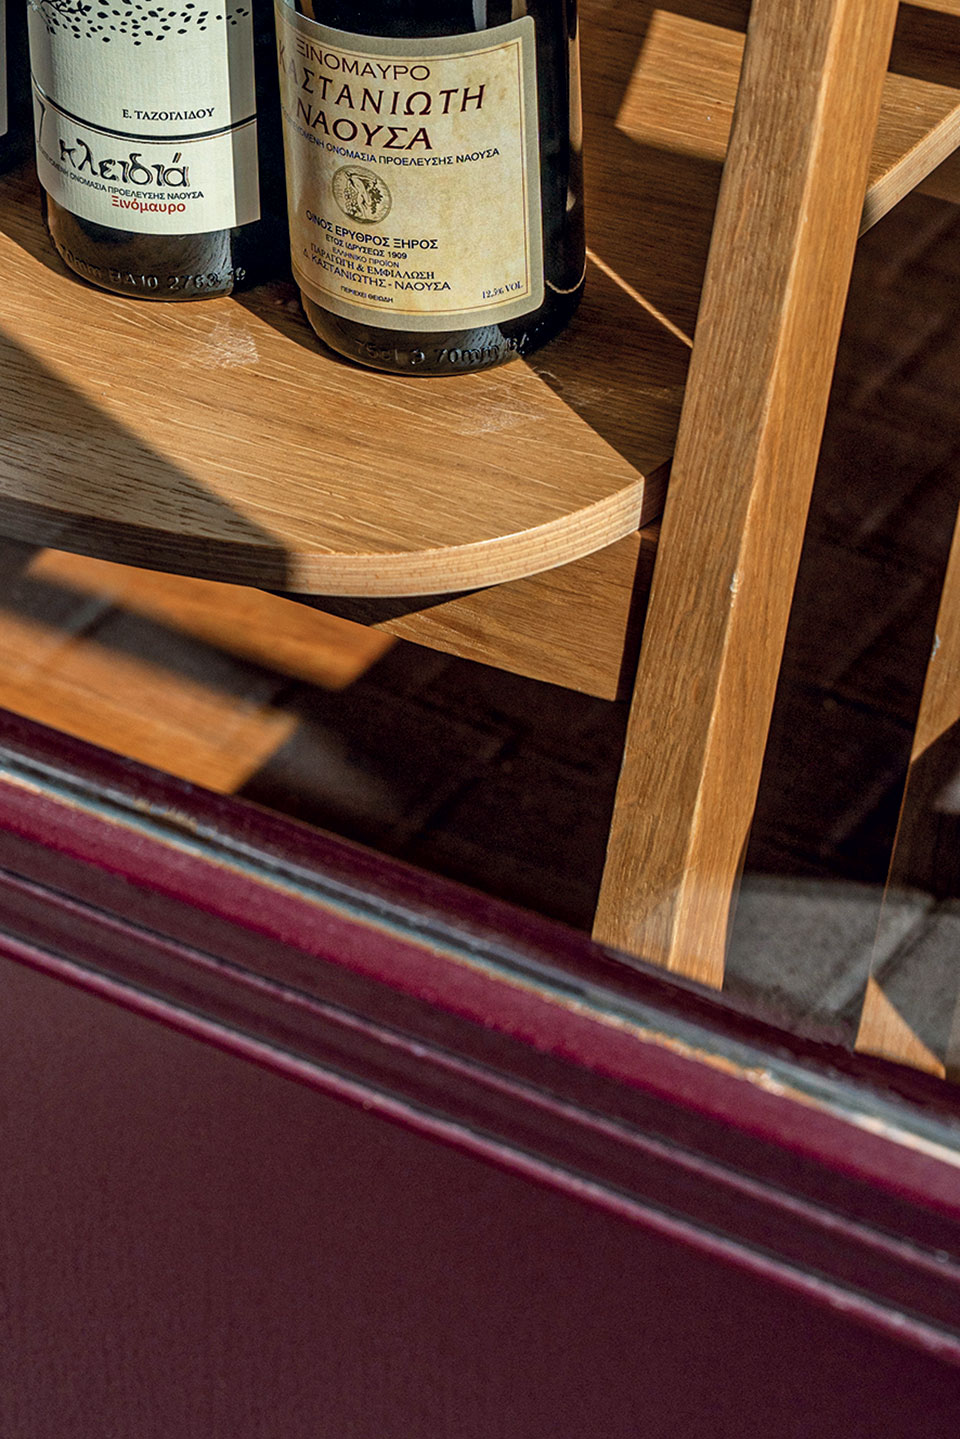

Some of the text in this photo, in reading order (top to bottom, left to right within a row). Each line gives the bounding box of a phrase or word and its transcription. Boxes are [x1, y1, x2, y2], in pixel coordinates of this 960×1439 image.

[296, 37, 430, 81] ΞΙΝΟΜΑΥΡΟ
[135, 107, 215, 121] ΤΑΖΟΓΛΙΔΟΥ
[297, 97, 433, 151] ΝΑΟΥΣΑ
[326, 142, 377, 163] ΟΝΟΜΑΣΙΑ
[378, 155, 454, 167] ΠΡΟΕΛΕΥΣΗΣ
[456, 147, 500, 163] ΝΑΟΥΣΑ
[108, 185, 165, 200] ΠΡΟΕΛΕΥΣΗΣ
[167, 191, 204, 200] ΝΑΟΥΣΑ
[111, 195, 186, 215] Ξινόμαυρο
[305, 210, 438, 250] ΟΙΝΟΣ ΕΡΥΘΡΟΣ ΞΗΡΟΣ
[325, 234, 344, 247] ΕΤΟΣ
[387, 251, 407, 260] 1909
[311, 255, 387, 288] ΚΑΣΤΑΝΙΩΤΗΣ
[394, 280, 451, 291] ΝΑΟΥΣΑ
[356, 263, 365, 273] &
[505, 280, 523, 292] VOL
